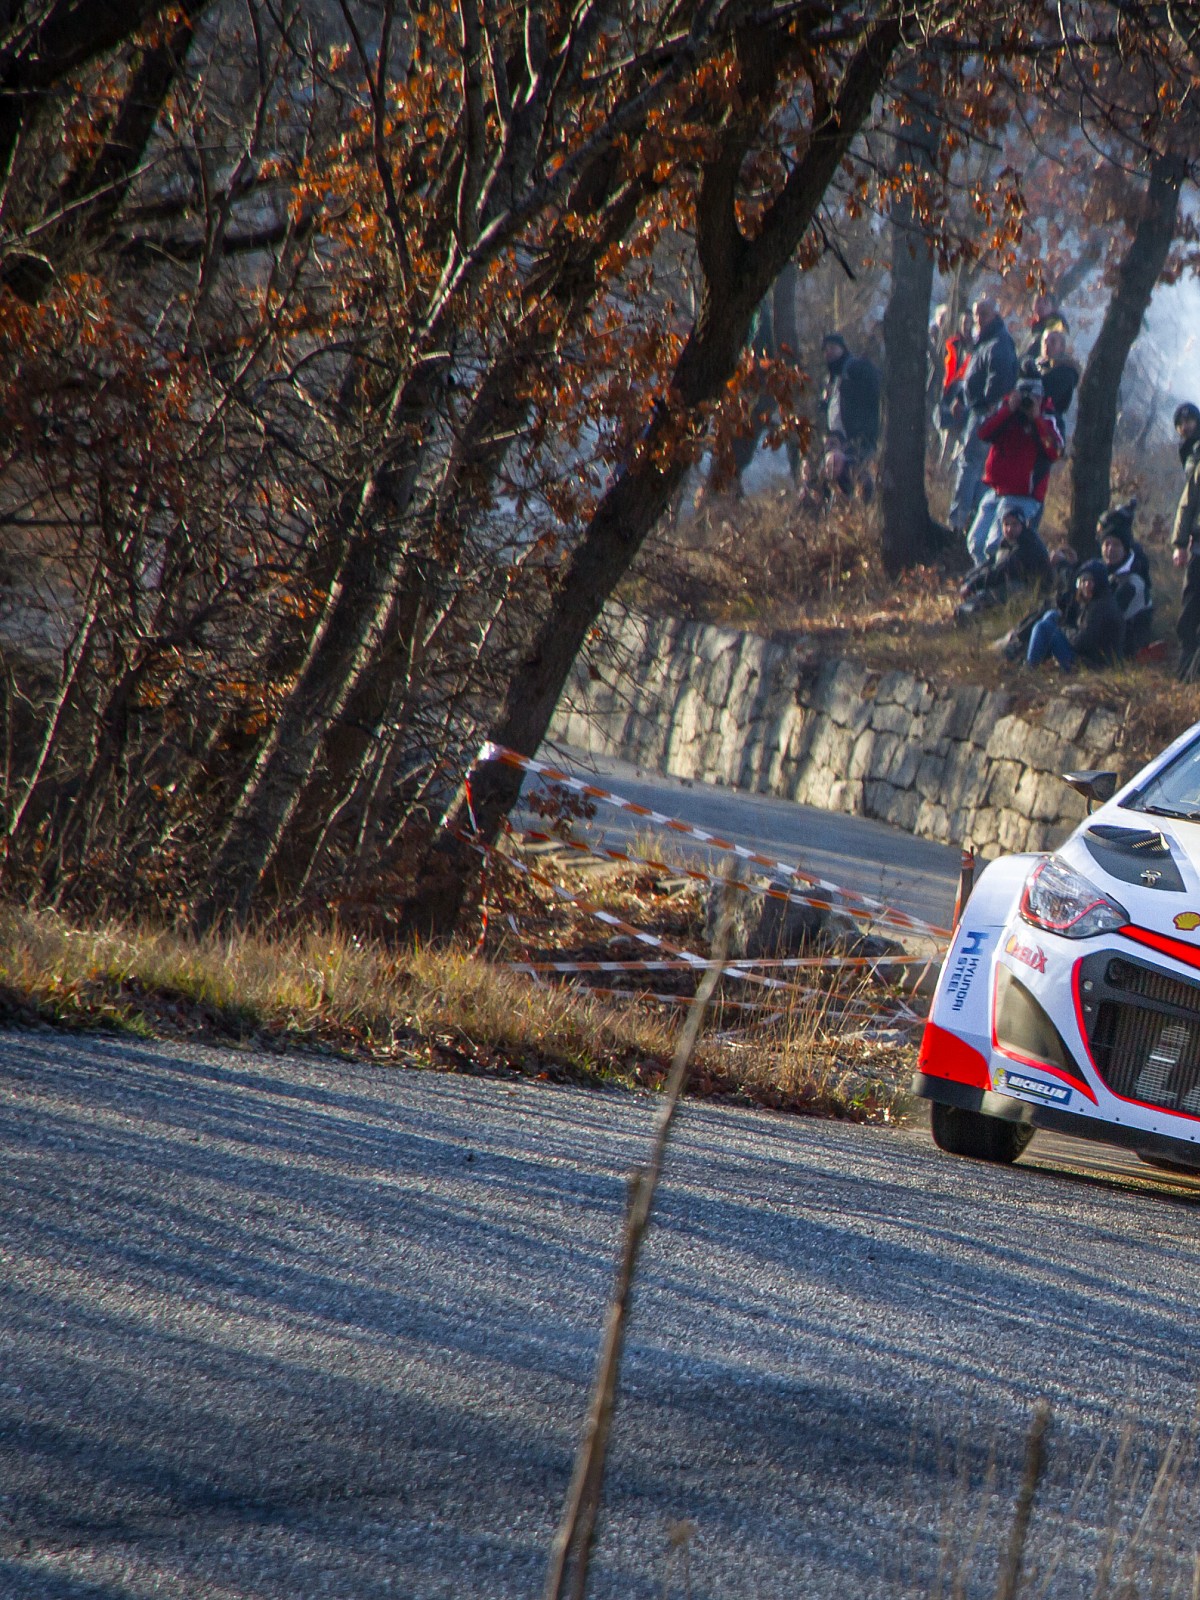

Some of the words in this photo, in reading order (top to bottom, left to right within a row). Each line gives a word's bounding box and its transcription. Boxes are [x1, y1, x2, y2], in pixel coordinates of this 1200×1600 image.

[1013, 942, 1049, 974] HELIX
[946, 957, 968, 994] STEEL
[951, 958, 980, 1011] HYUNDAI
[1008, 1076, 1068, 1099] MICHELIN
